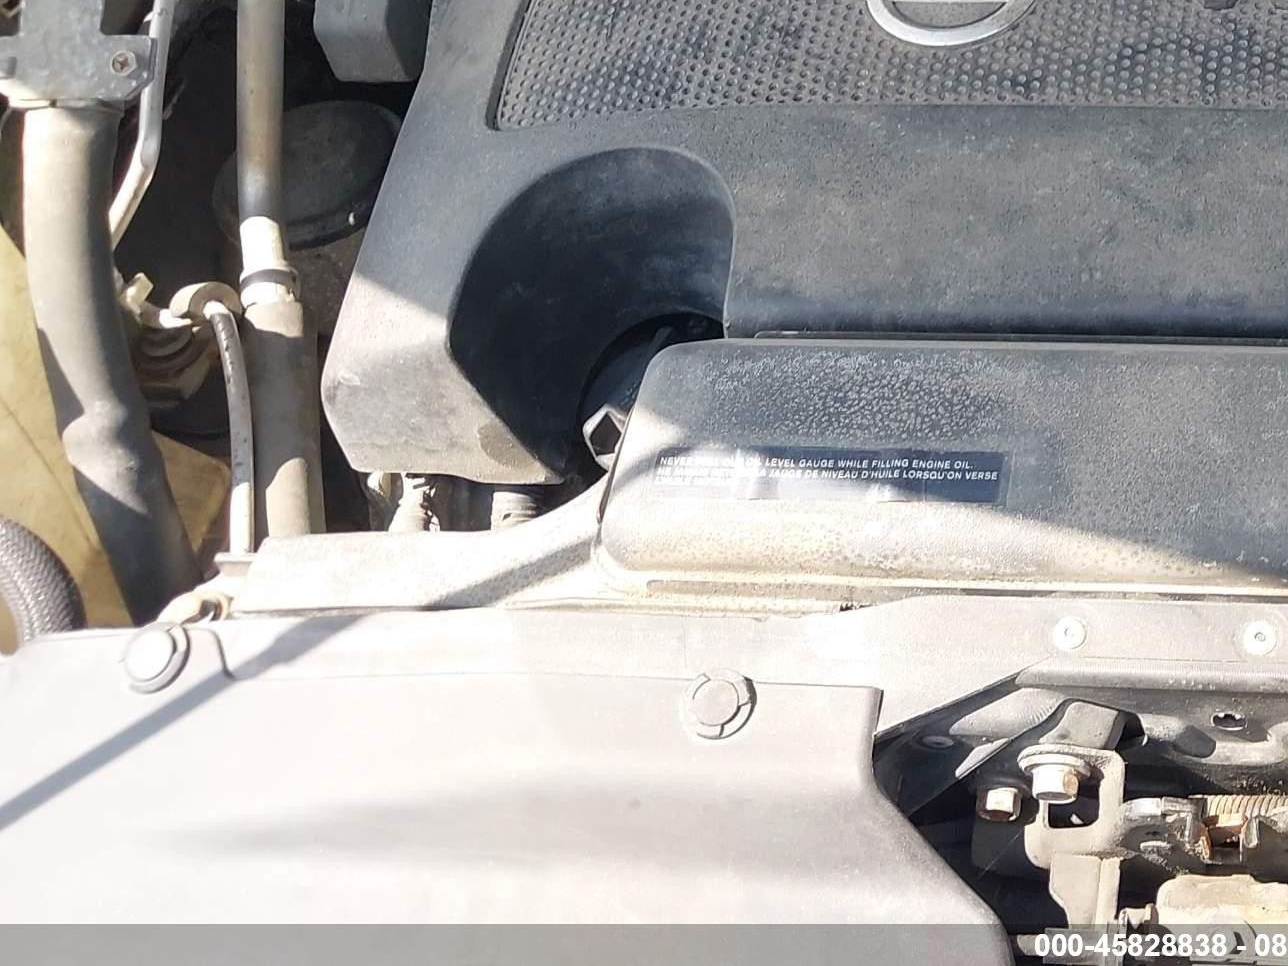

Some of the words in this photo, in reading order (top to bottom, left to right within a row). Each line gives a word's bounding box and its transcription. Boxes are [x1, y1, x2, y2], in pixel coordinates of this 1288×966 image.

[765, 458, 796, 468] LEVEL
[799, 458, 835, 468] GAUGE
[837, 459, 869, 469] WHILE
[871, 459, 909, 469] FILLING
[912, 459, 951, 469] ENGINE
[953, 460, 974, 470] OIL.
[805, 469, 818, 479] DE
[821, 470, 859, 480] NIVEAU
[861, 469, 900, 479] D'HUILE
[965, 471, 999, 481] VERSE
